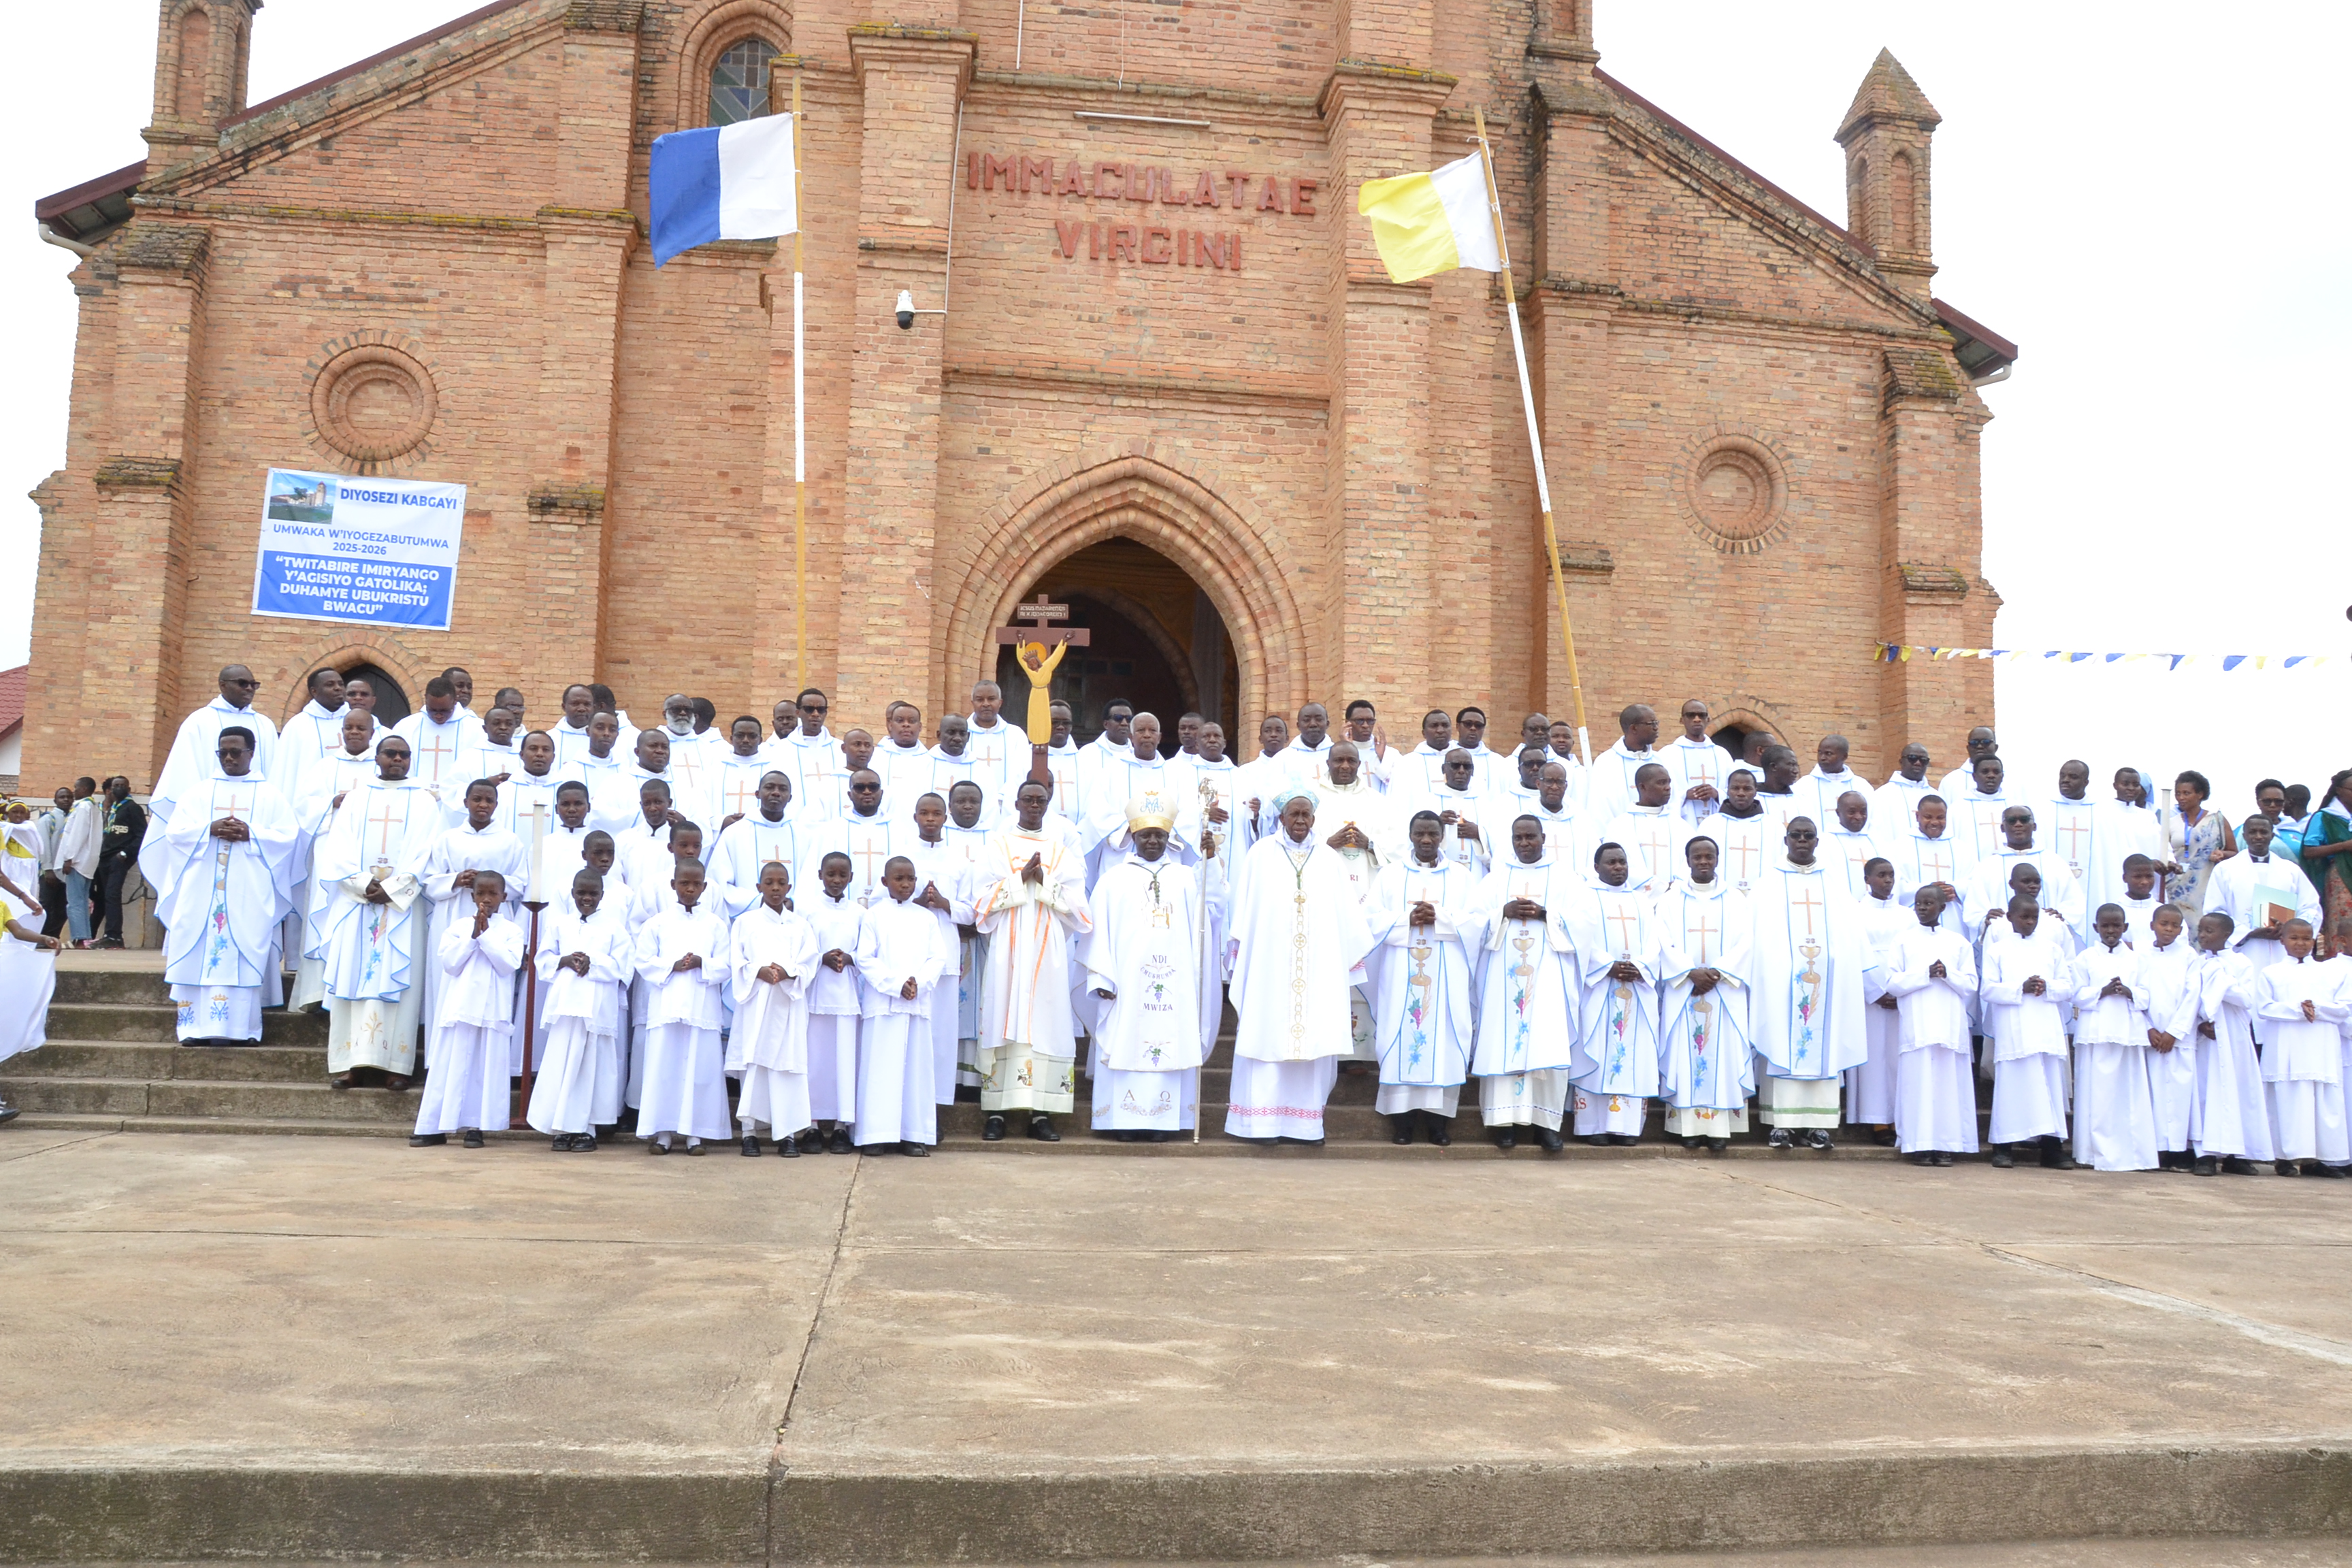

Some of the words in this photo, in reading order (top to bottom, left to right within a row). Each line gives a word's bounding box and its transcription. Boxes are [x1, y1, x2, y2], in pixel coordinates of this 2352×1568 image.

[968, 151, 1317, 215] IMMACULATAE
[1055, 220, 1241, 271] VIRGINI
[340, 488, 398, 504] DIYOSEZI
[402, 493, 457, 510] KABGAYI
[274, 523, 325, 537] UMWAKA
[332, 542, 387, 555] 2025-2026
[361, 564, 440, 581] IMIRYANGO
[355, 576, 427, 595] GATOLIKA;
[280, 583, 348, 599] DUHAMYE
[351, 589, 429, 606] UBUKRISTU
[1152, 954, 1167, 964] NDI
[1140, 966, 1176, 980] UMUSHUMBA
[1143, 1002, 1173, 1011] MWIZA
